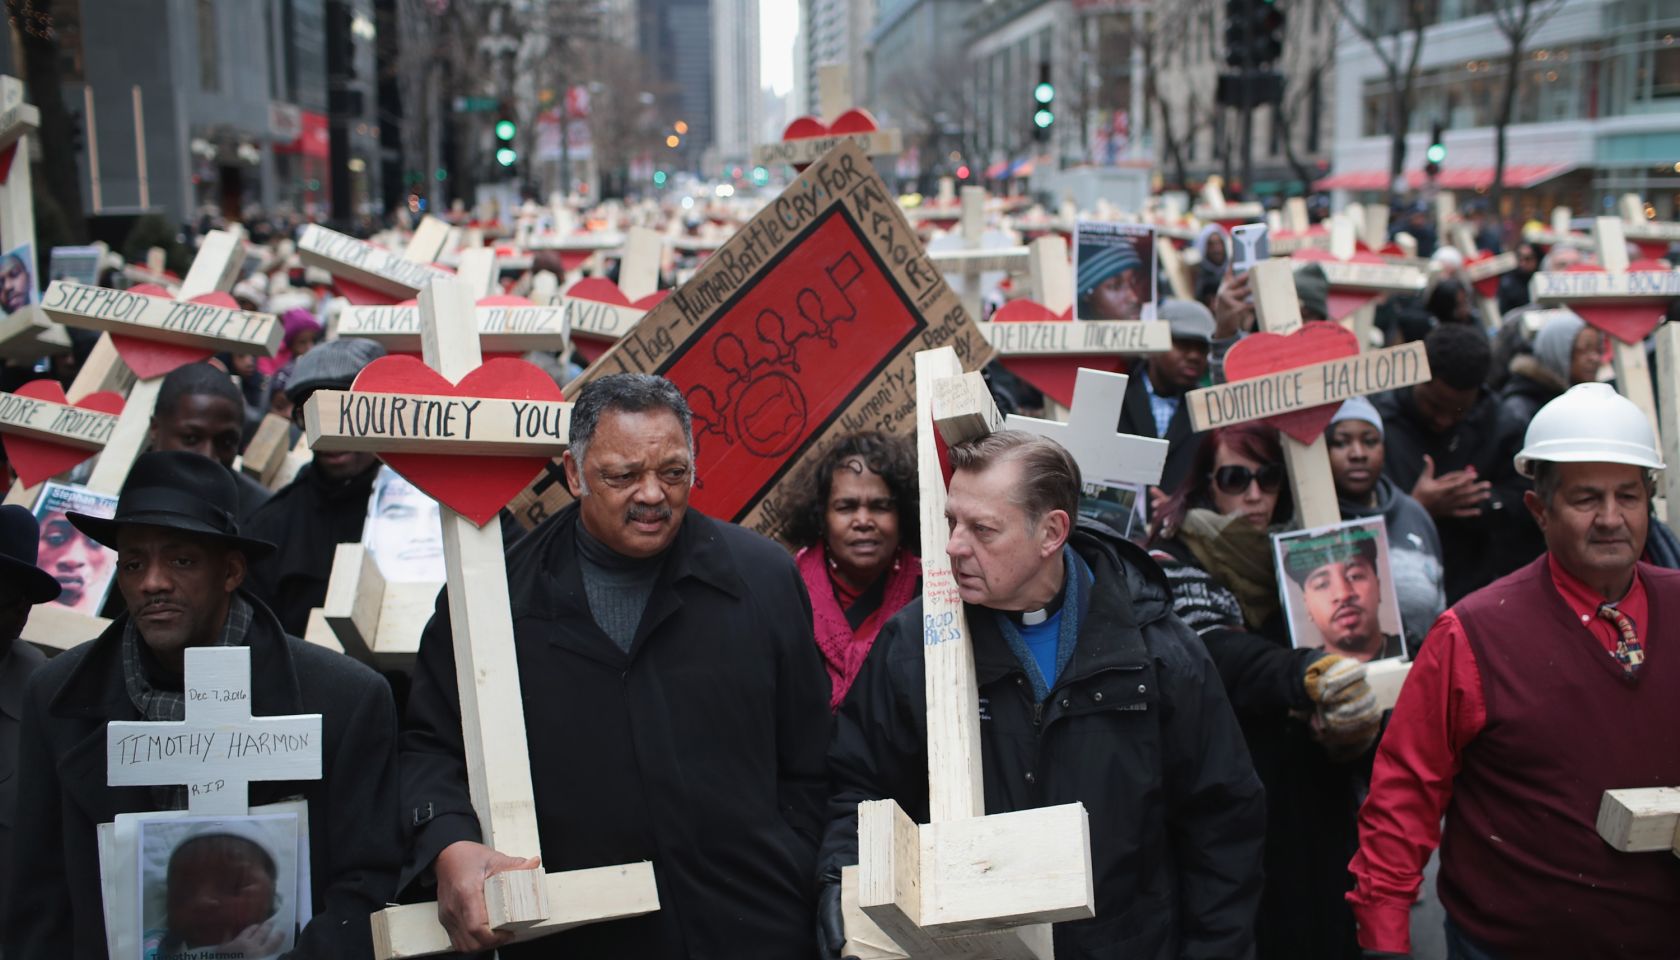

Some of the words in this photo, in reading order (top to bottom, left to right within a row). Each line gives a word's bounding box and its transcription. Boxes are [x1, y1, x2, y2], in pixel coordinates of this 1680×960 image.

[51, 284, 149, 322] STEPHON
[160, 301, 270, 341] TRIPLETT
[348, 307, 422, 331] SALVA
[991, 323, 1069, 350] DENZELL
[1205, 371, 1303, 425] DOMINICE
[339, 394, 481, 439] KOURTNEY
[511, 401, 561, 439] YOU
[925, 611, 953, 629] GOD
[189, 689, 208, 701] Dec
[117, 731, 216, 765] TIMOTHY
[227, 731, 309, 760] HARMON
